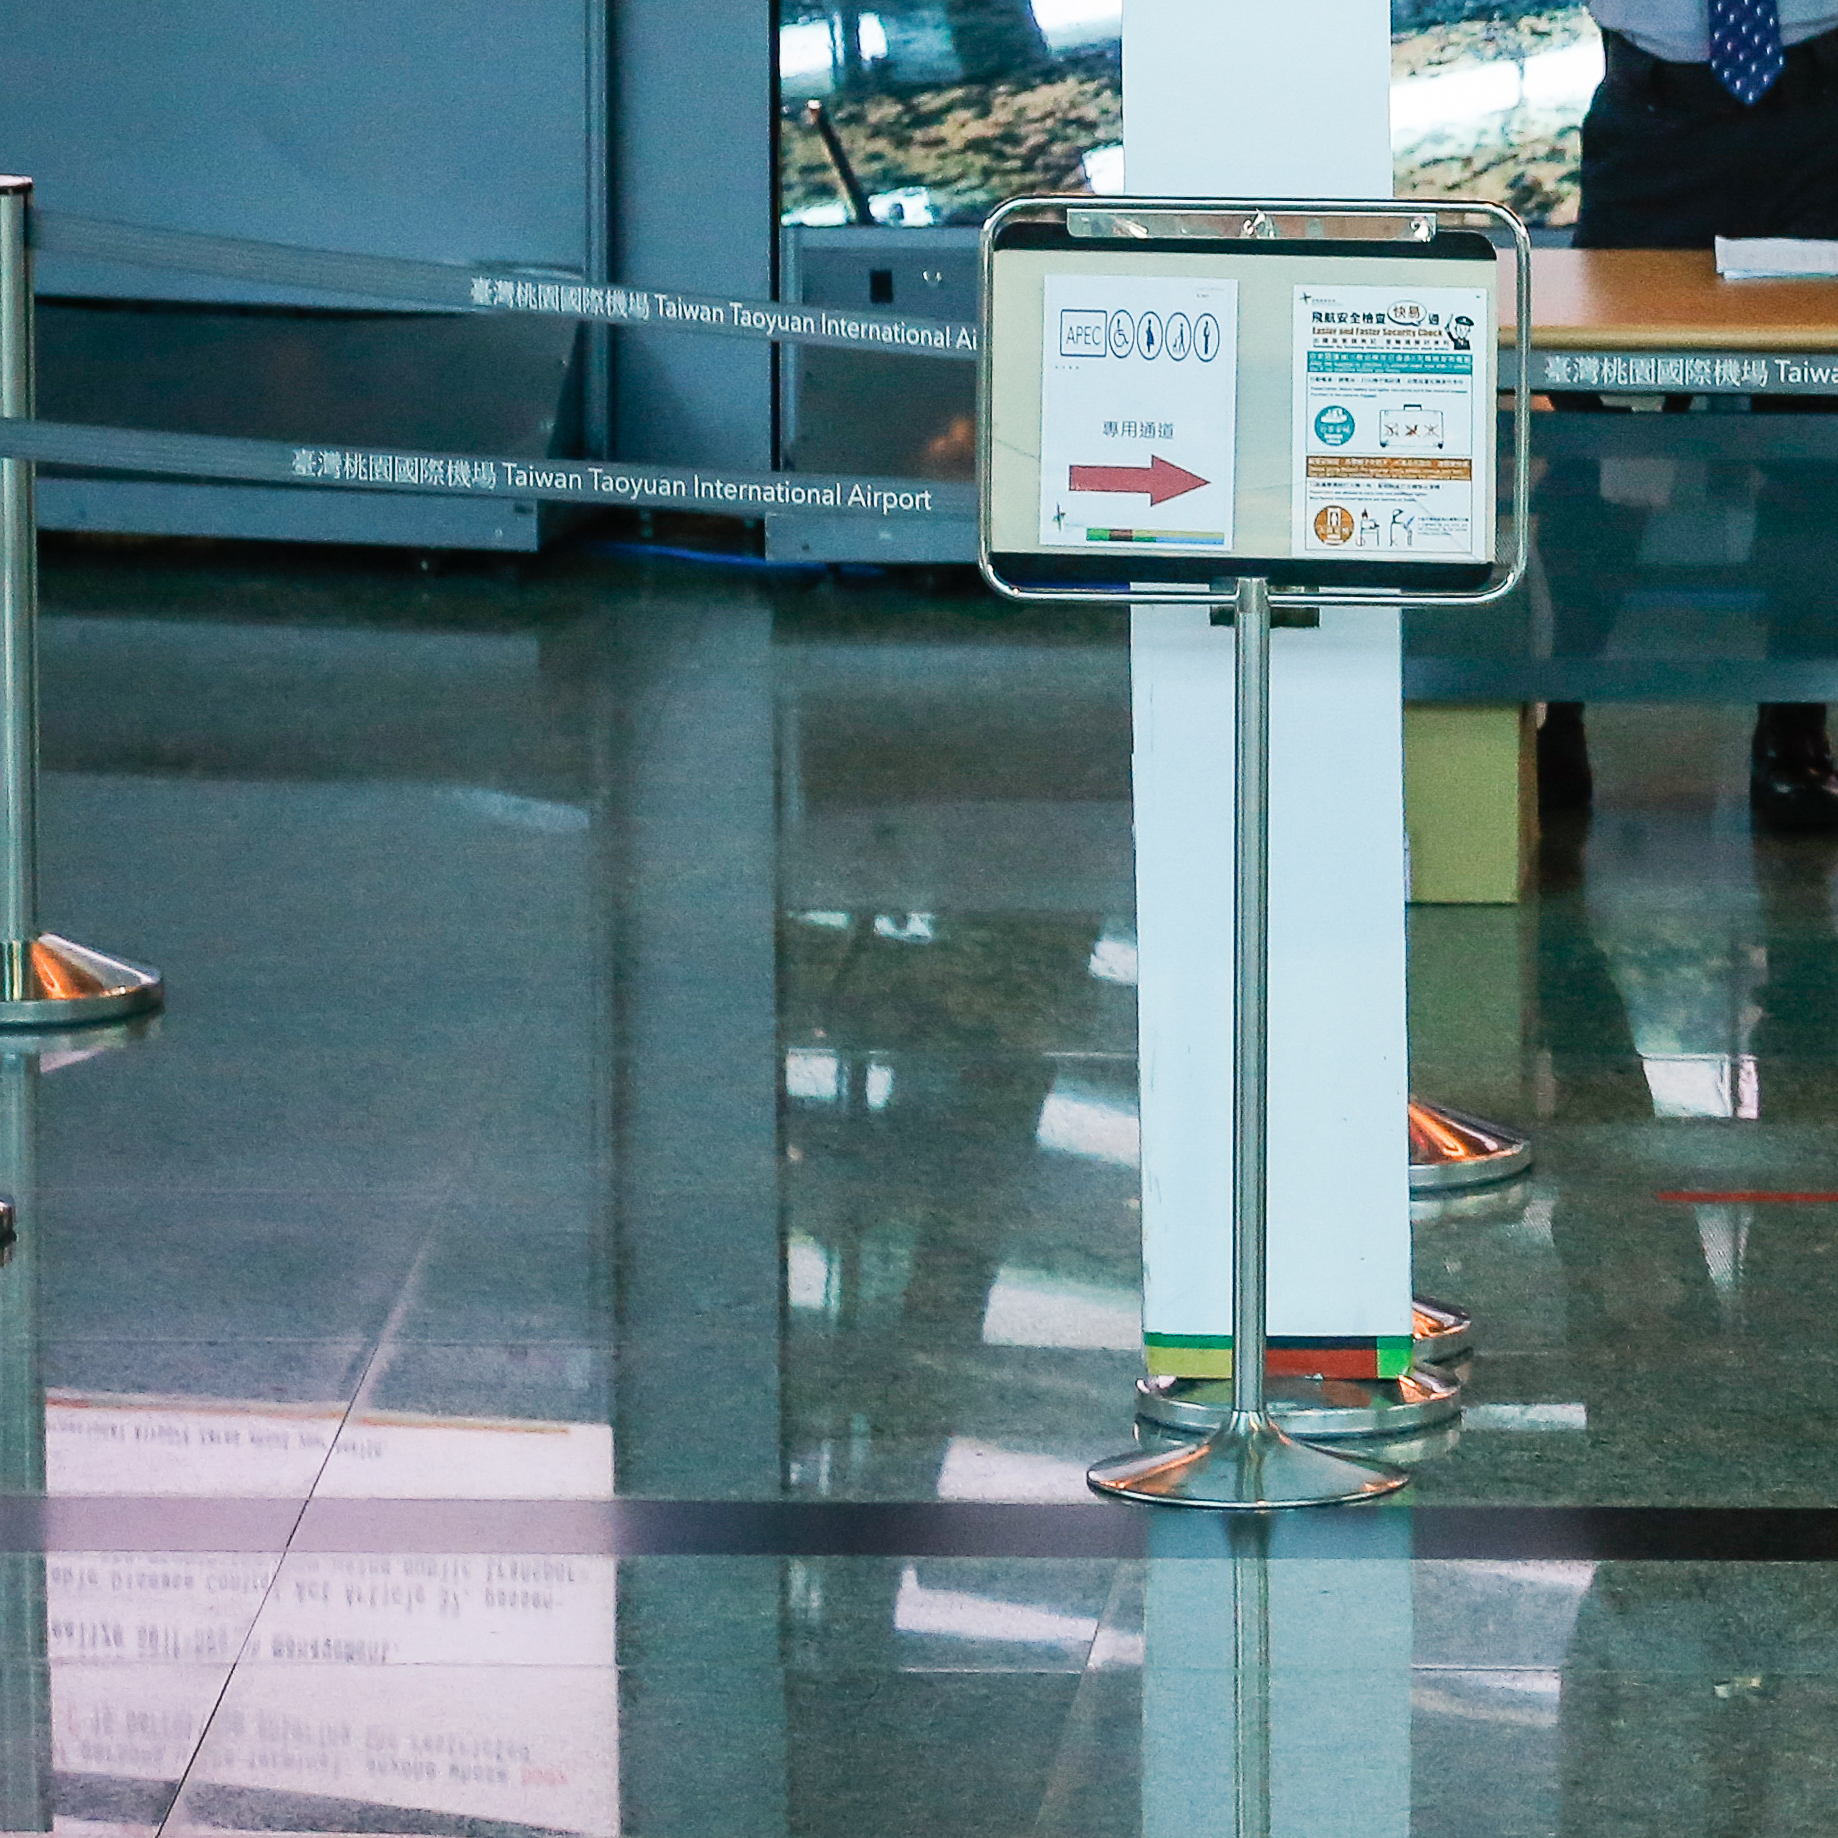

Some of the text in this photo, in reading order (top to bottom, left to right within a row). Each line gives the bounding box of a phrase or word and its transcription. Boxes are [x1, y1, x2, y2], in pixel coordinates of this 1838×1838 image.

[654, 294, 724, 323] Taiwan
[730, 302, 815, 336] Taoyuan
[821, 313, 951, 349] International
[1065, 324, 1102, 346] APEC
[1101, 420, 1175, 441] 專用通道
[502, 462, 583, 493] Taiwan
[588, 466, 688, 501] Taoyuan
[694, 473, 843, 508] International
[848, 482, 933, 515] Airport
